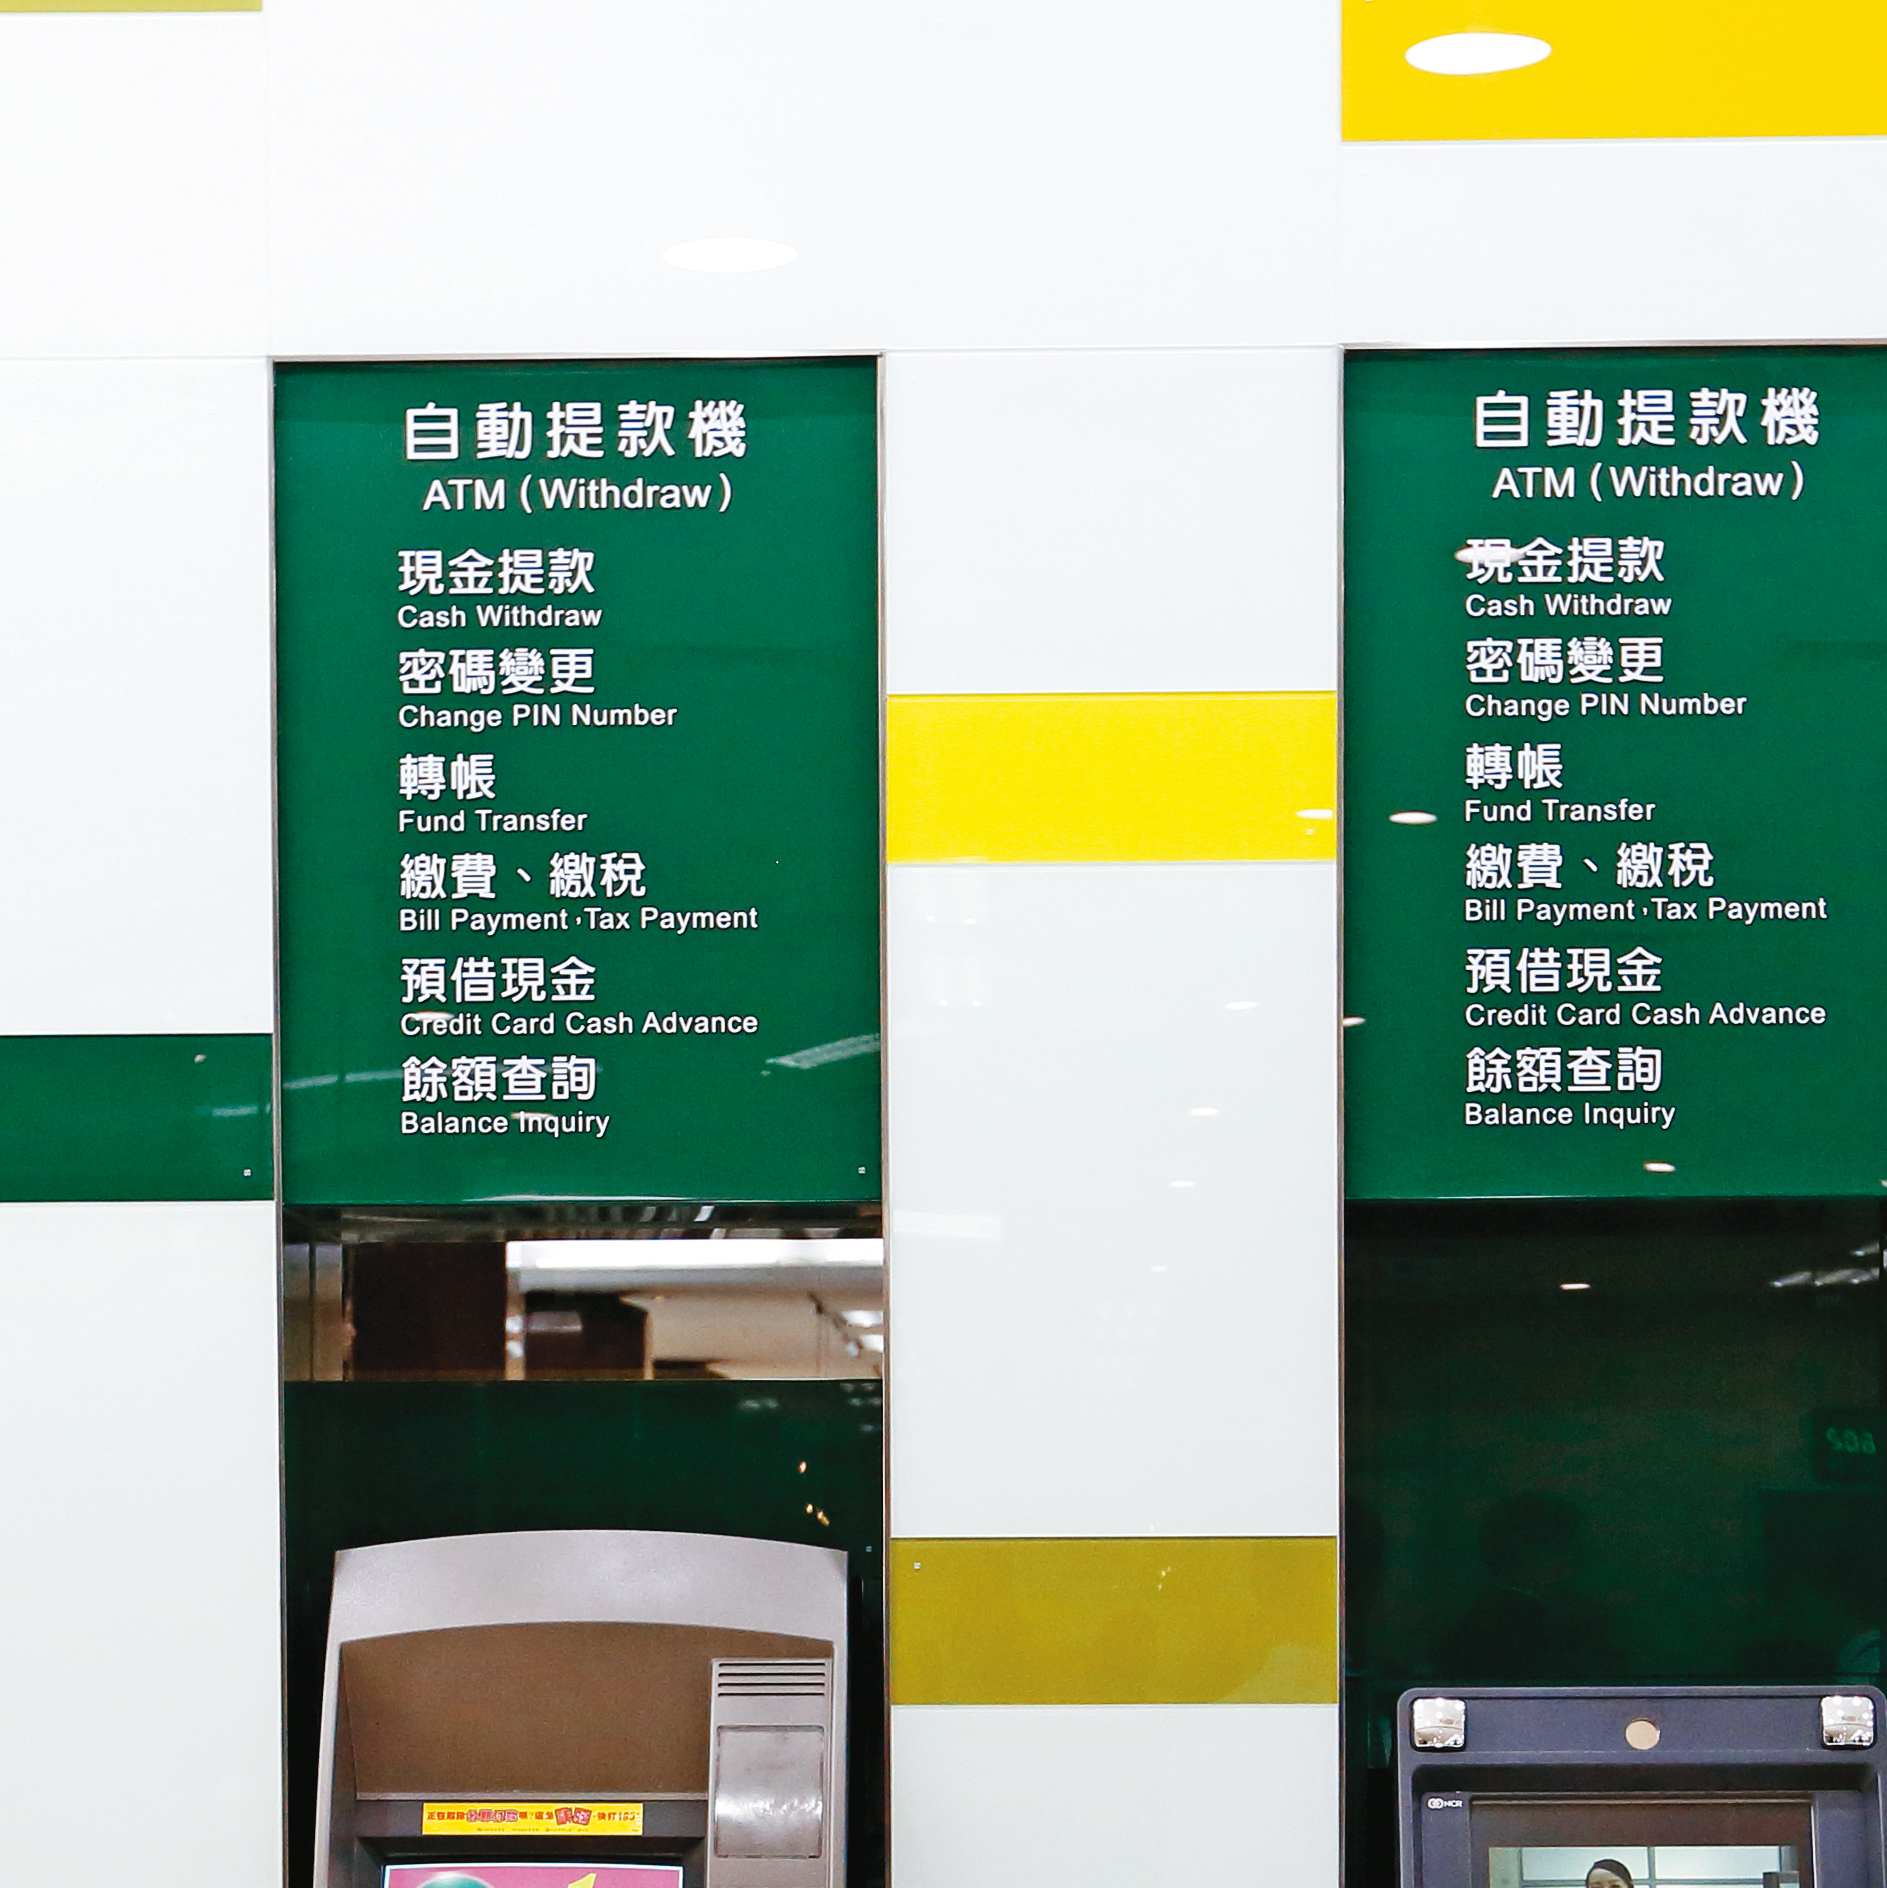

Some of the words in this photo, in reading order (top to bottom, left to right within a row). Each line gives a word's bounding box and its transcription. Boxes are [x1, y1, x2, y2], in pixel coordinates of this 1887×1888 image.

[405, 399, 746, 460] 自動提款機
[1476, 387, 1819, 448] 自動提款機
[422, 478, 505, 511] ATM
[1492, 466, 1575, 499] ATM
[397, 547, 595, 596] 現金提款
[397, 605, 466, 628] Cash
[476, 604, 603, 627] Withdraw
[1465, 593, 1535, 617] Cash
[1544, 593, 1672, 616] Withdraw
[398, 647, 595, 695] 密碼變更
[1465, 636, 1664, 684] 密碼變更
[399, 704, 502, 733] Change
[513, 703, 560, 727] PIN
[572, 703, 678, 726] Number
[1465, 693, 1570, 722] Change
[1581, 693, 1629, 715] PIN
[1640, 692, 1747, 715] Number
[399, 753, 496, 801] 轉帳
[1465, 742, 1563, 790] 轉帳
[399, 809, 465, 832] Fund
[474, 808, 588, 832] Transfer
[1465, 799, 1531, 822] Fund
[1541, 798, 1656, 822] Transfer
[400, 908, 441, 931] Bill
[641, 907, 758, 935] Payment
[1465, 898, 1506, 921] Bill
[1708, 897, 1828, 925] Payment
[400, 955, 596, 1003] 預借現金
[1465, 946, 1663, 994] 預借現金
[400, 1013, 482, 1036] Credit
[491, 1012, 555, 1035] Card
[565, 1011, 633, 1034] Cash
[641, 1011, 758, 1034] Advance
[1465, 1003, 1547, 1026] Credit
[1556, 1002, 1620, 1026] Card
[1631, 1002, 1700, 1025] Cash
[1708, 1002, 1826, 1025] Advance
[401, 1054, 596, 1103] 餘額查詢
[1466, 1045, 1662, 1093] 餘額查詢
[401, 1111, 508, 1134] Balance
[518, 1111, 610, 1138] Inquiry
[1465, 1102, 1573, 1125] Balance
[1584, 1101, 1676, 1130] Inquiry
